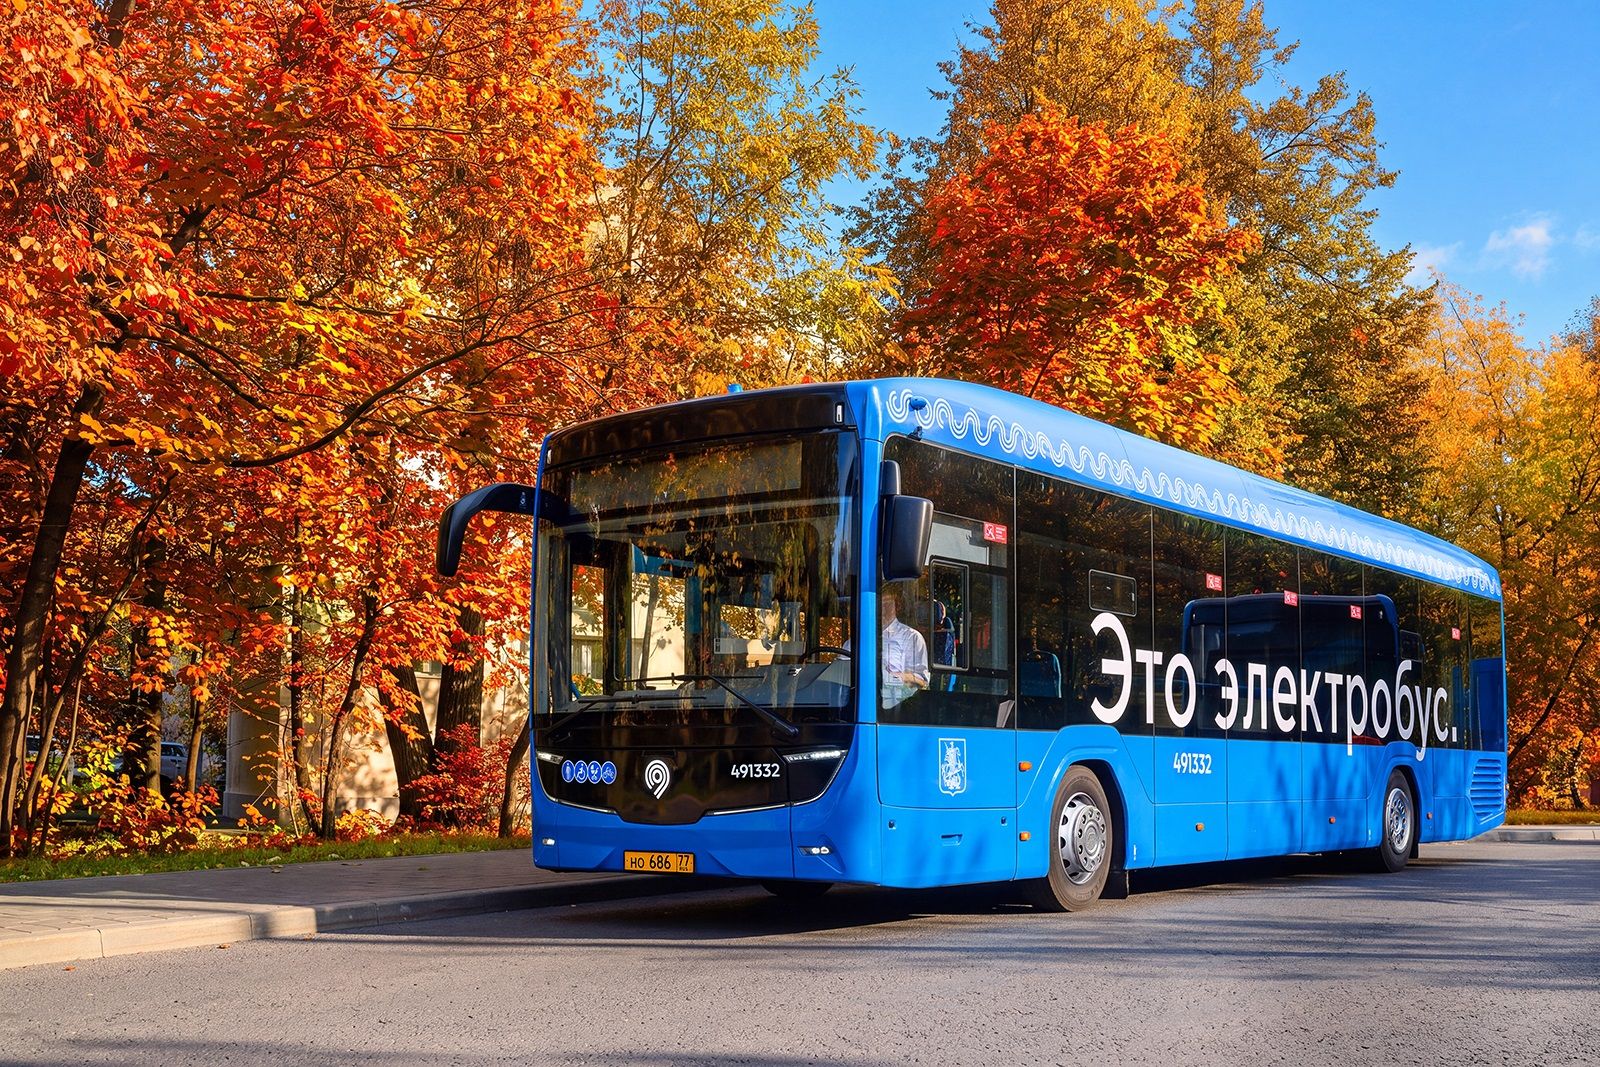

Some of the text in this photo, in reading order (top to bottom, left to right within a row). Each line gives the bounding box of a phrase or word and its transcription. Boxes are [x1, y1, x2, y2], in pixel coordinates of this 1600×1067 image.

[1090, 612, 1458, 762] Это электробус.
[730, 763, 781, 779] 491332
[1173, 752, 1213, 775] 491332
[649, 854, 672, 870] 686
[678, 854, 690, 867] 77
